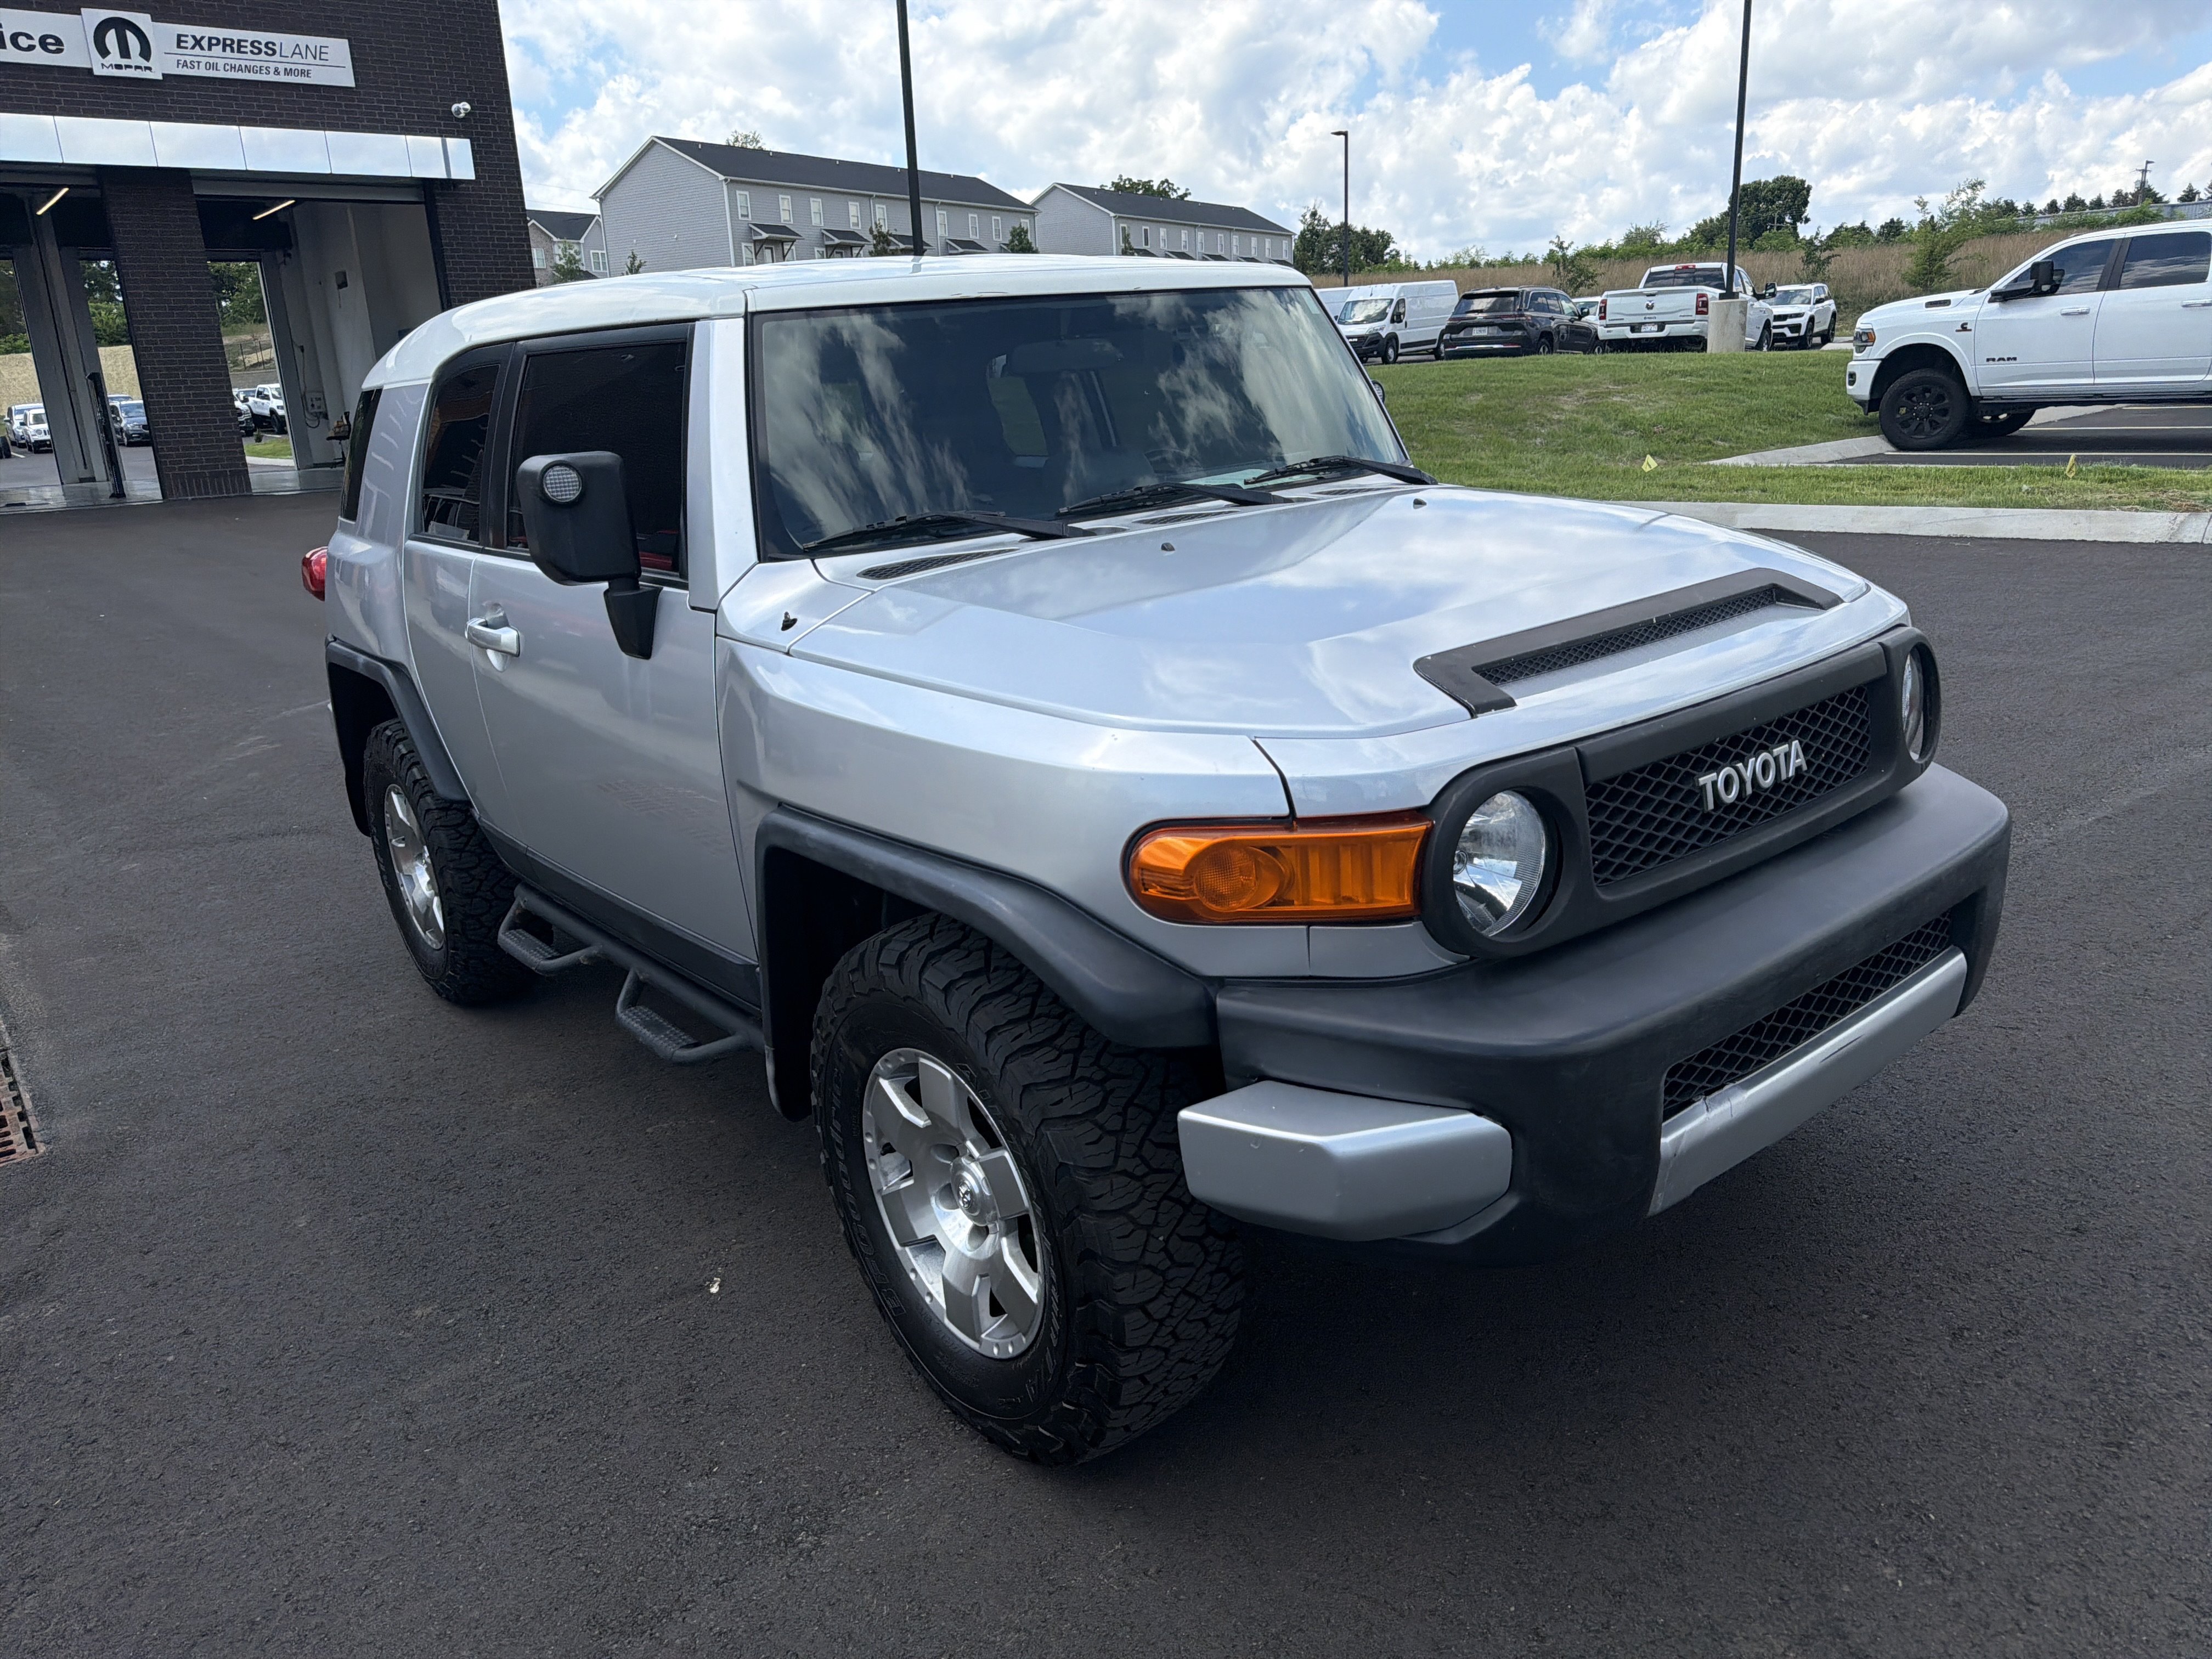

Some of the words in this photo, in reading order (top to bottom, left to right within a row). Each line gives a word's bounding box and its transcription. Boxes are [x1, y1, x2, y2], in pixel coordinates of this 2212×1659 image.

[101, 63, 154, 72] MOPAR
[176, 59, 202, 70] FAST
[205, 61, 221, 72] OIL
[223, 63, 270, 75] CHANGES
[273, 66, 281, 76] &
[284, 67, 312, 78] MORE
[1698, 740, 1808, 811] TOYOTA
